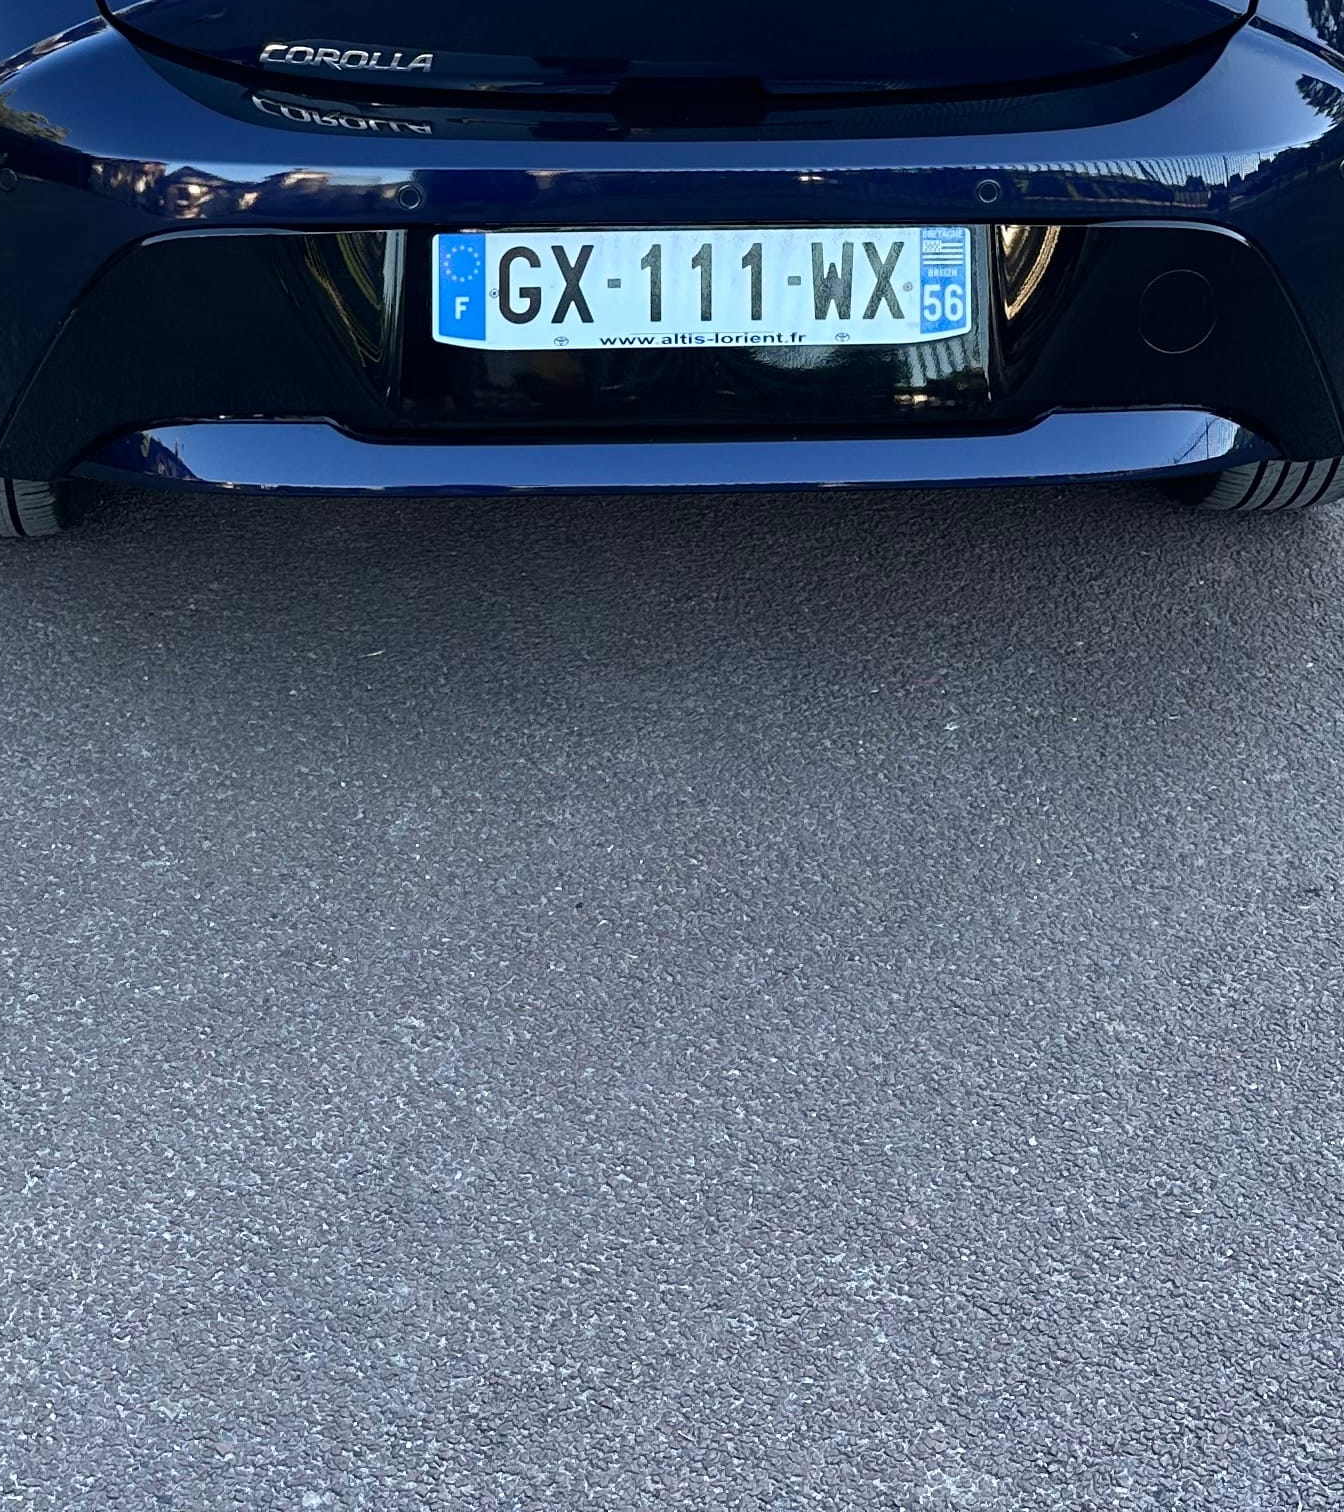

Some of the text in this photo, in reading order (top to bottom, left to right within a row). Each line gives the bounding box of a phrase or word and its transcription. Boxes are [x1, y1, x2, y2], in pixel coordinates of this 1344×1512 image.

[258, 43, 434, 73] COROLLA
[498, 243, 905, 324] GX-111-WX
[454, 296, 470, 320] F
[923, 283, 964, 322] 56
[600, 331, 806, 346] www.altis-lorient.fr
